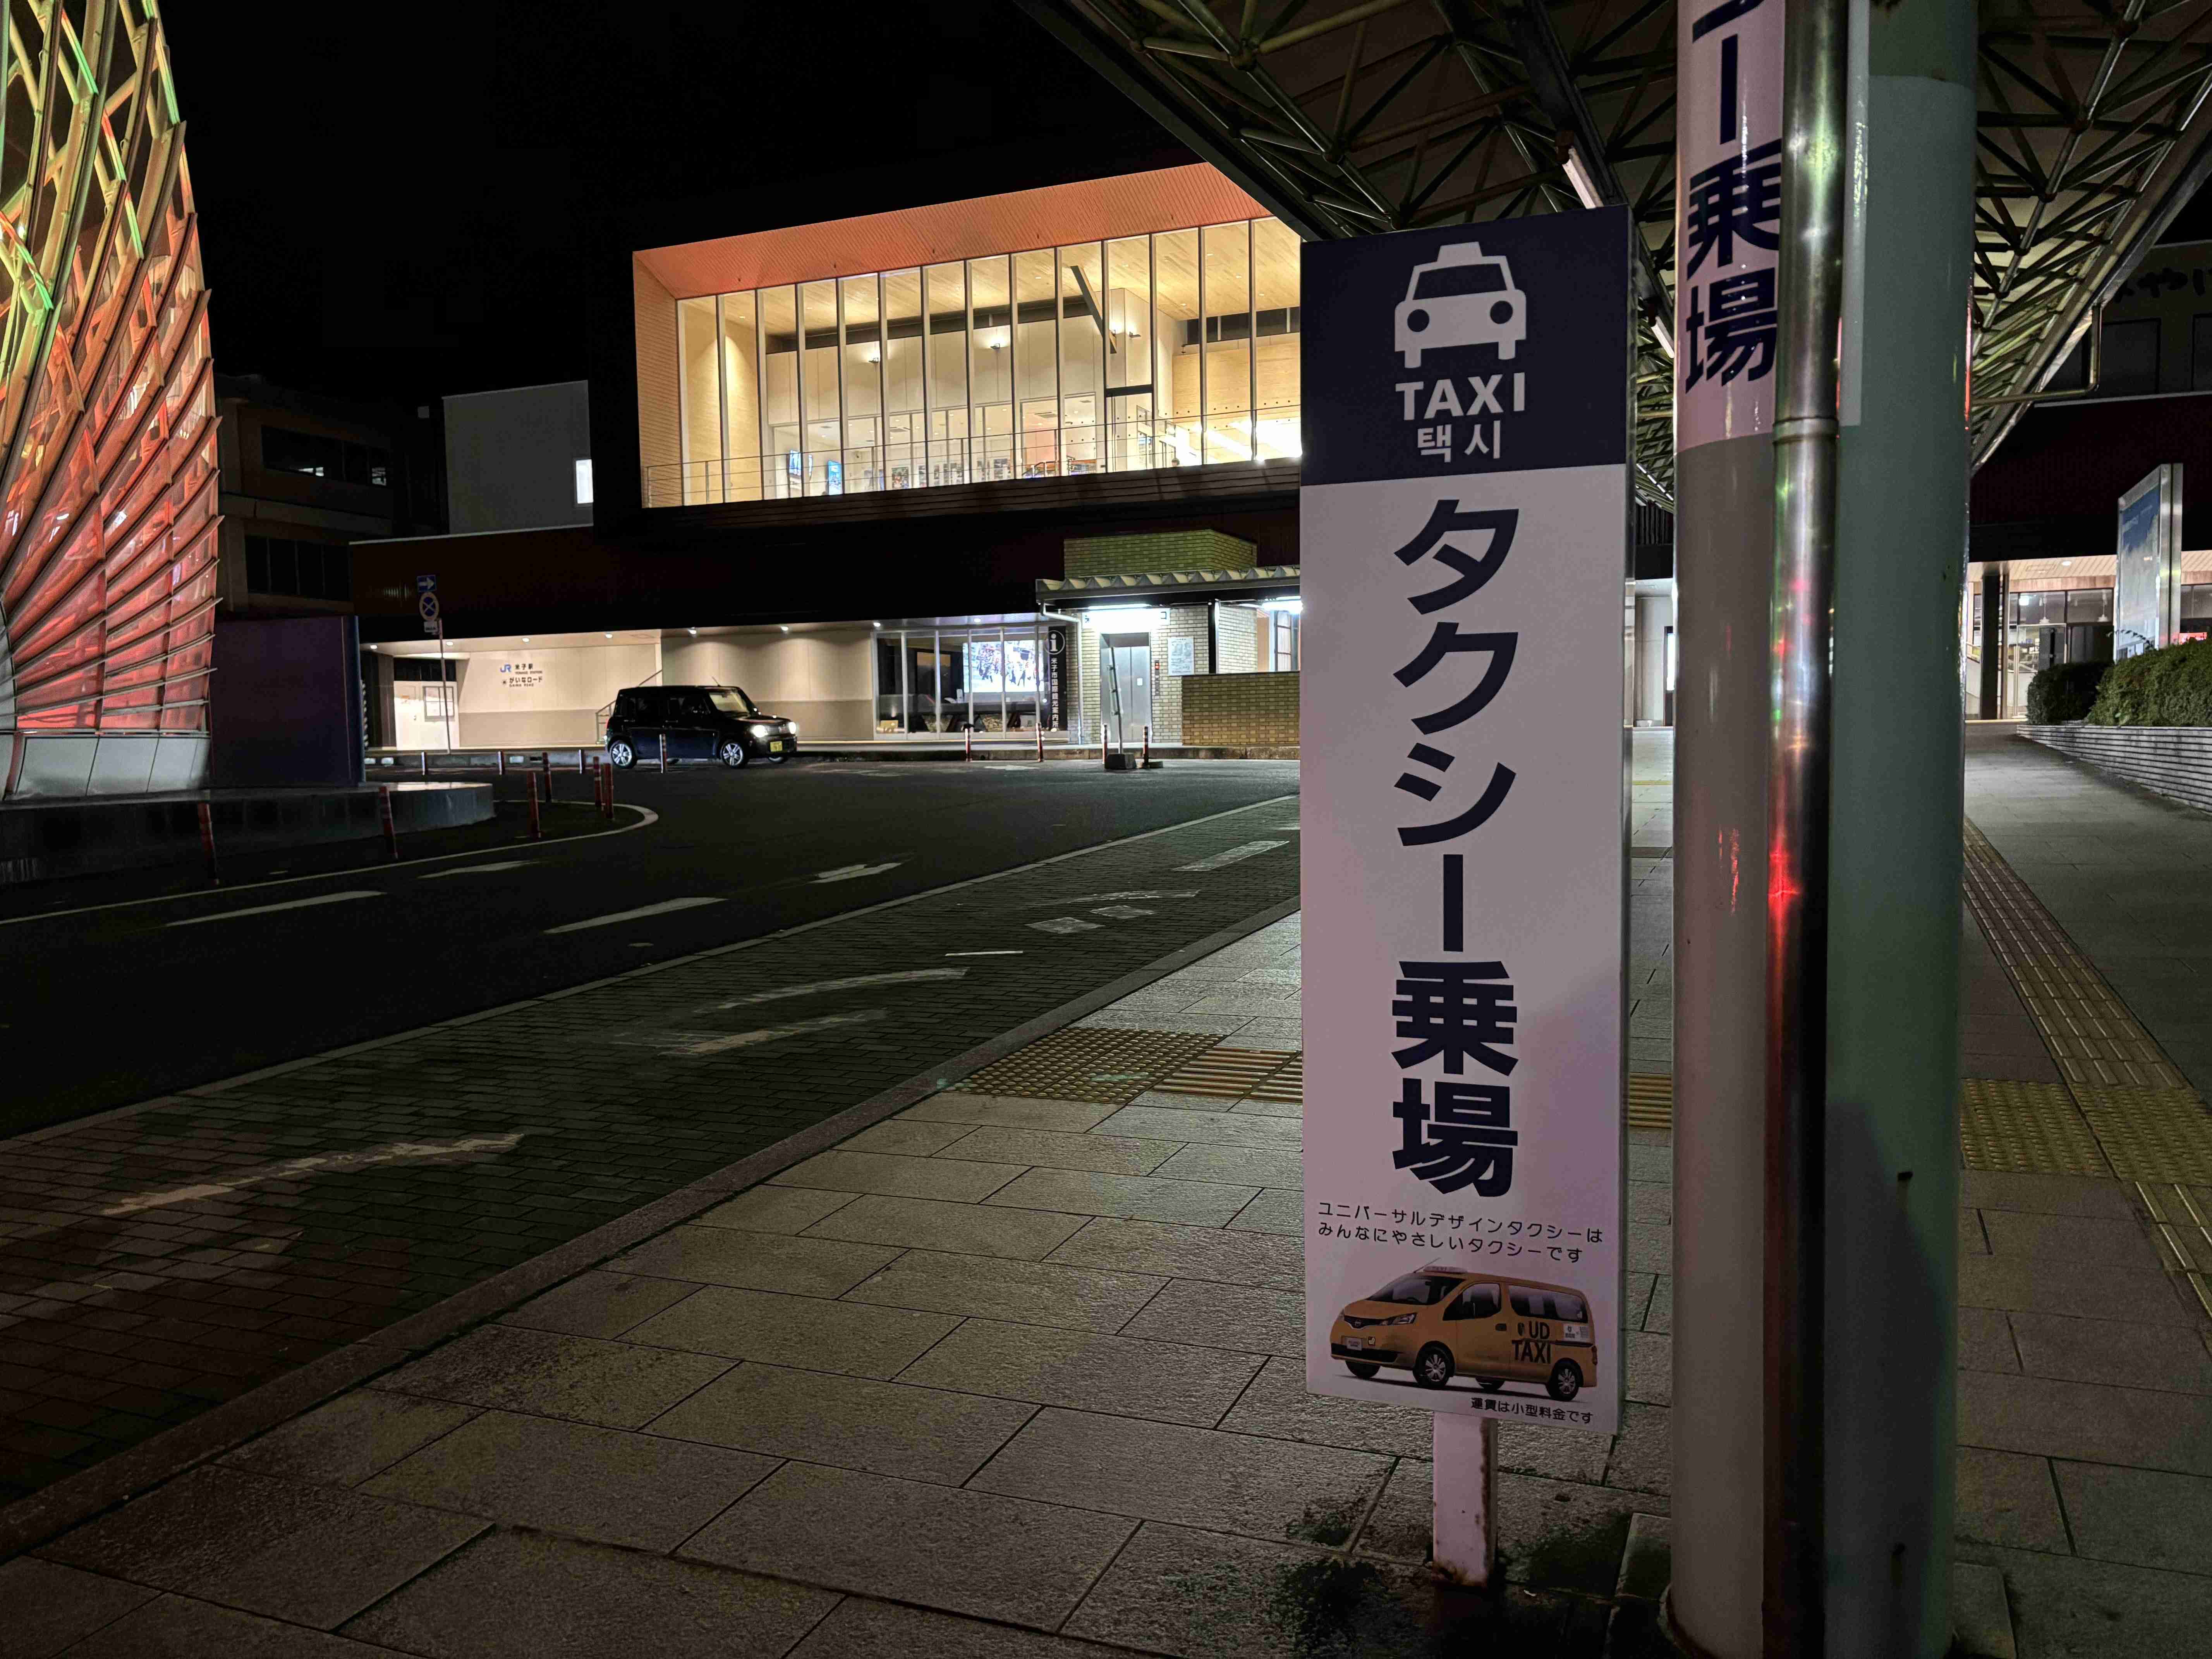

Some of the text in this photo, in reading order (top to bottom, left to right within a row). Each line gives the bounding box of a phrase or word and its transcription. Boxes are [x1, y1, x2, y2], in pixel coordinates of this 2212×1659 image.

[1686, 0, 1781, 394] ー乗場
[1395, 372, 1525, 421] TAXI
[1417, 420, 1501, 463] 택시
[500, 664, 512, 673] JR
[1392, 499, 1519, 1197] タクシー乗場
[1318, 1202, 1604, 1243] ユニバーサルデザインタクシーは
[1318, 1222, 1583, 1263] みんなにやさしいタクシーです
[1529, 1321, 1550, 1340] UD
[1511, 1339, 1551, 1364] TAXI
[1471, 1397, 1593, 1424] 運賃は小型料金です
